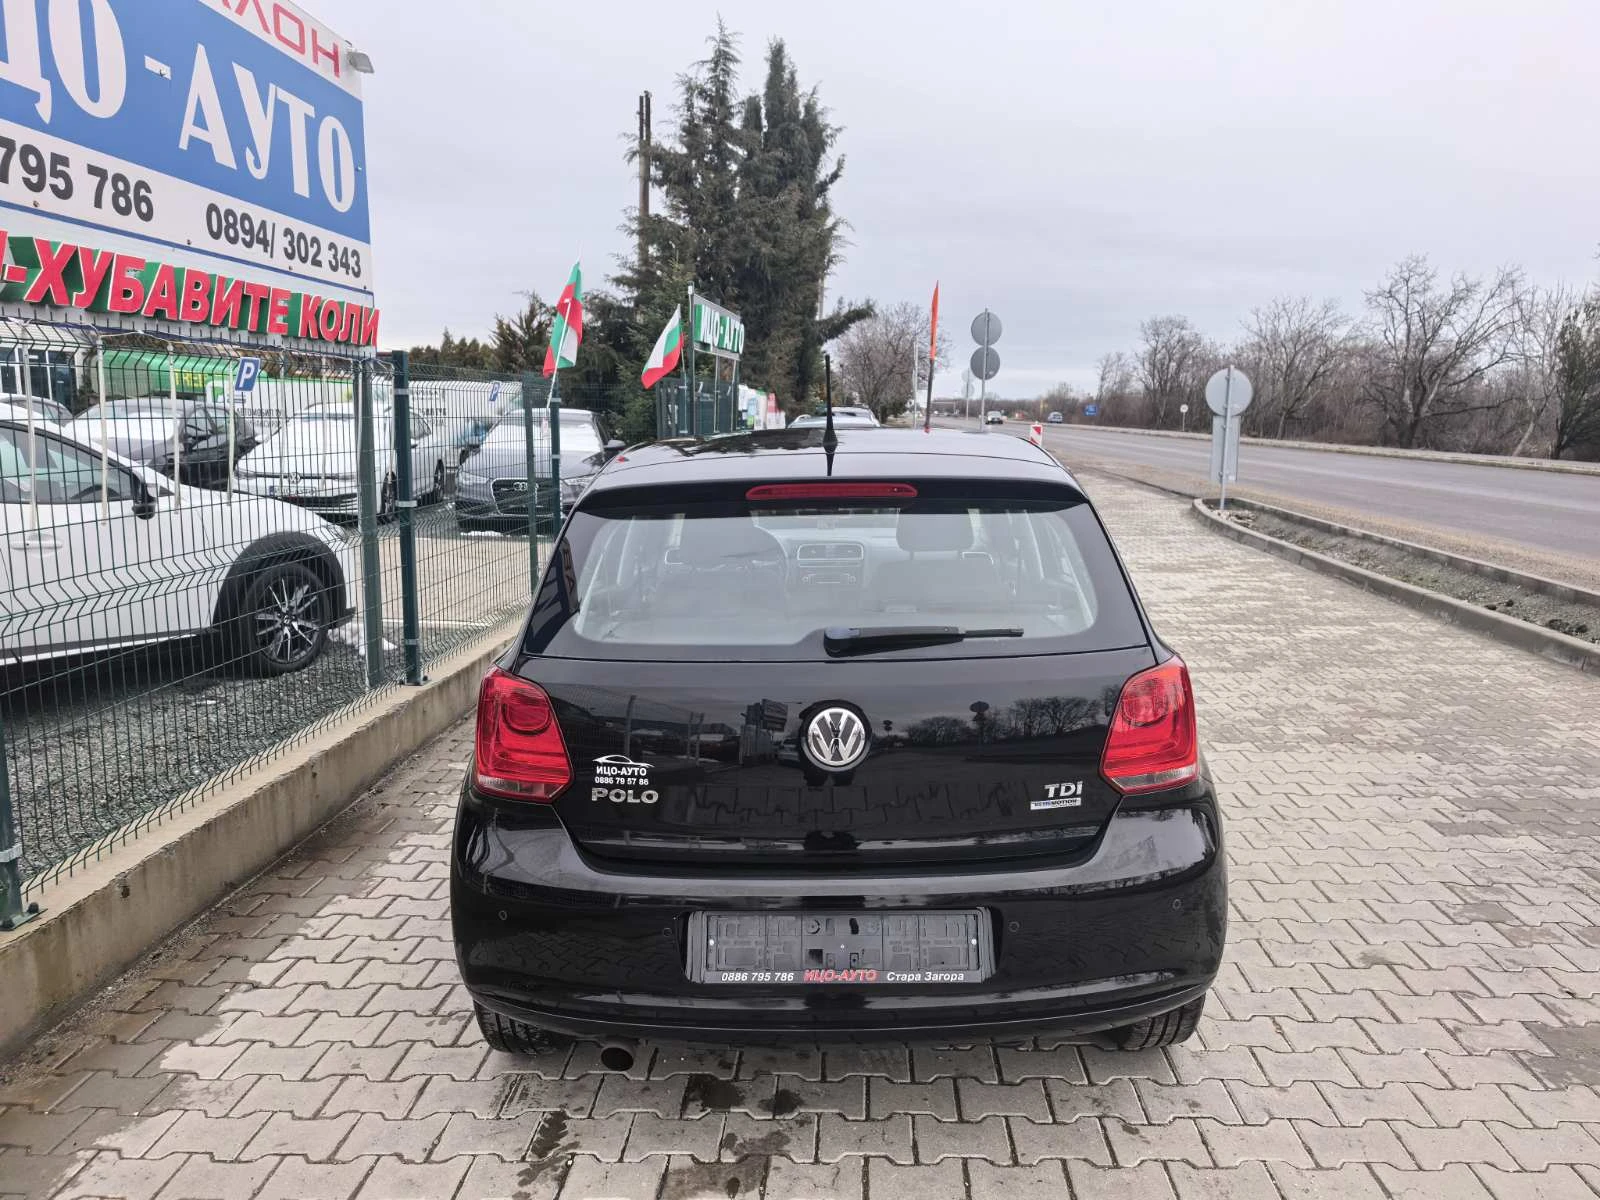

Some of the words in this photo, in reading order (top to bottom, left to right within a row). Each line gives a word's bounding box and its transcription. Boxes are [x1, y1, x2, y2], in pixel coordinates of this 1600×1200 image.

[220, 0, 340, 78] ЛОН
[0, 135, 74, 201] 795
[87, 163, 154, 222] 786
[283, 227, 322, 269] 302
[328, 242, 361, 278] 343
[300, 294, 380, 346] КОЛИ
[701, 304, 744, 354] ИЦО-АУТО
[239, 361, 256, 388] P
[596, 766, 647, 776] ИЦО-АУТО
[591, 787, 659, 804] POLO
[721, 972, 748, 982] 0886
[752, 972, 771, 982] 795
[774, 972, 794, 982] 786
[803, 968, 878, 984] ИЦО-АУТО
[886, 971, 921, 983] Стара
[924, 971, 965, 983] Загора
